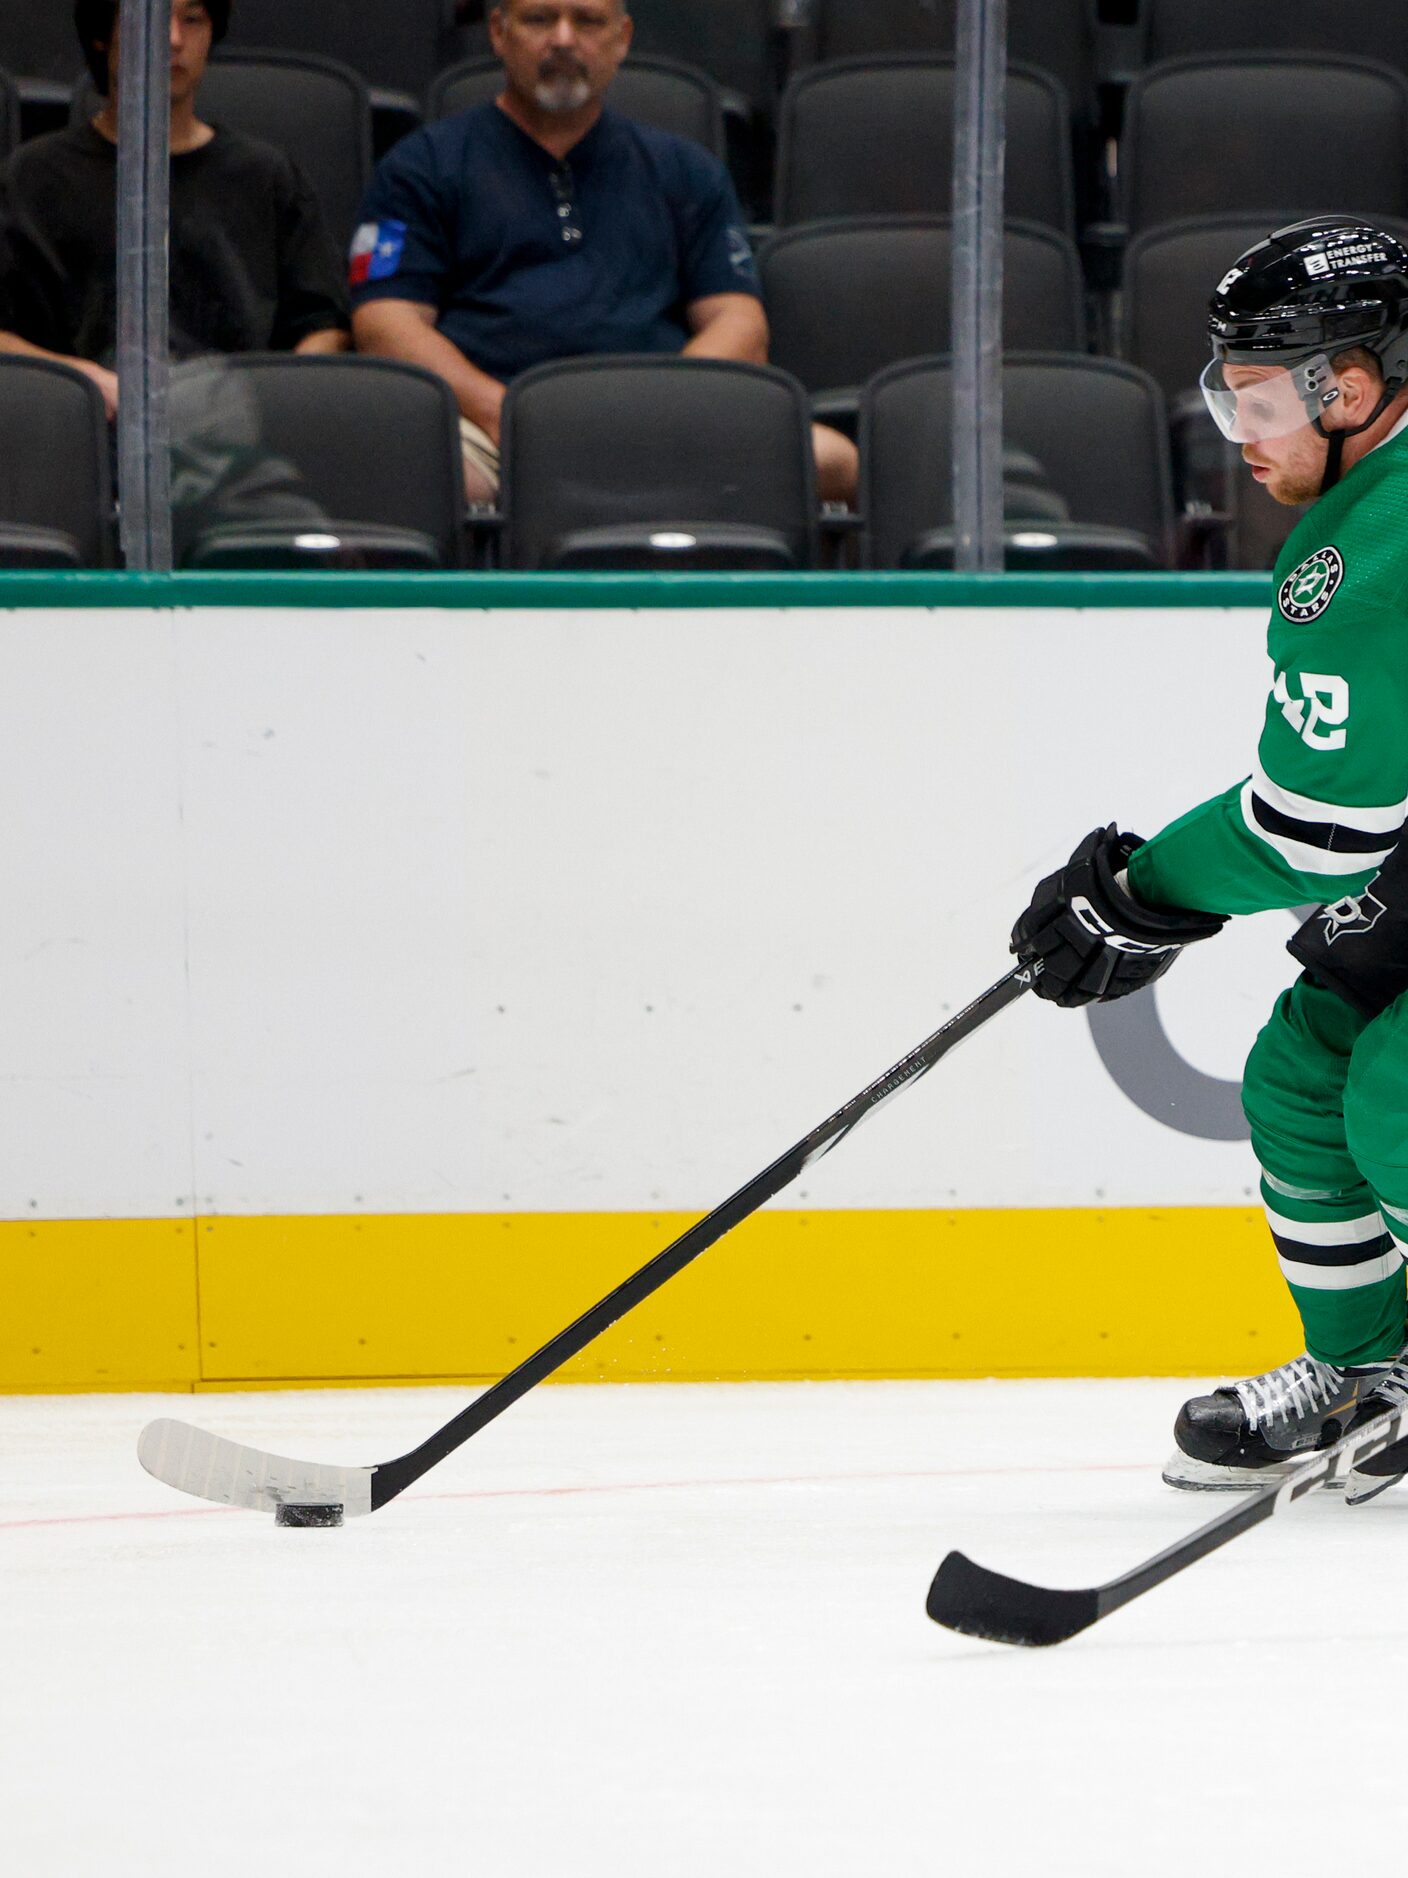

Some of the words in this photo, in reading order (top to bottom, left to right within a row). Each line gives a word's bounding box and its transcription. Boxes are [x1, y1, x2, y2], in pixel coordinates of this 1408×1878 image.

[1326, 243, 1372, 259] ENERGY
[1329, 252, 1388, 270] TRANSFER
[1288, 551, 1339, 582] DALLAS
[1282, 590, 1329, 617] STARS
